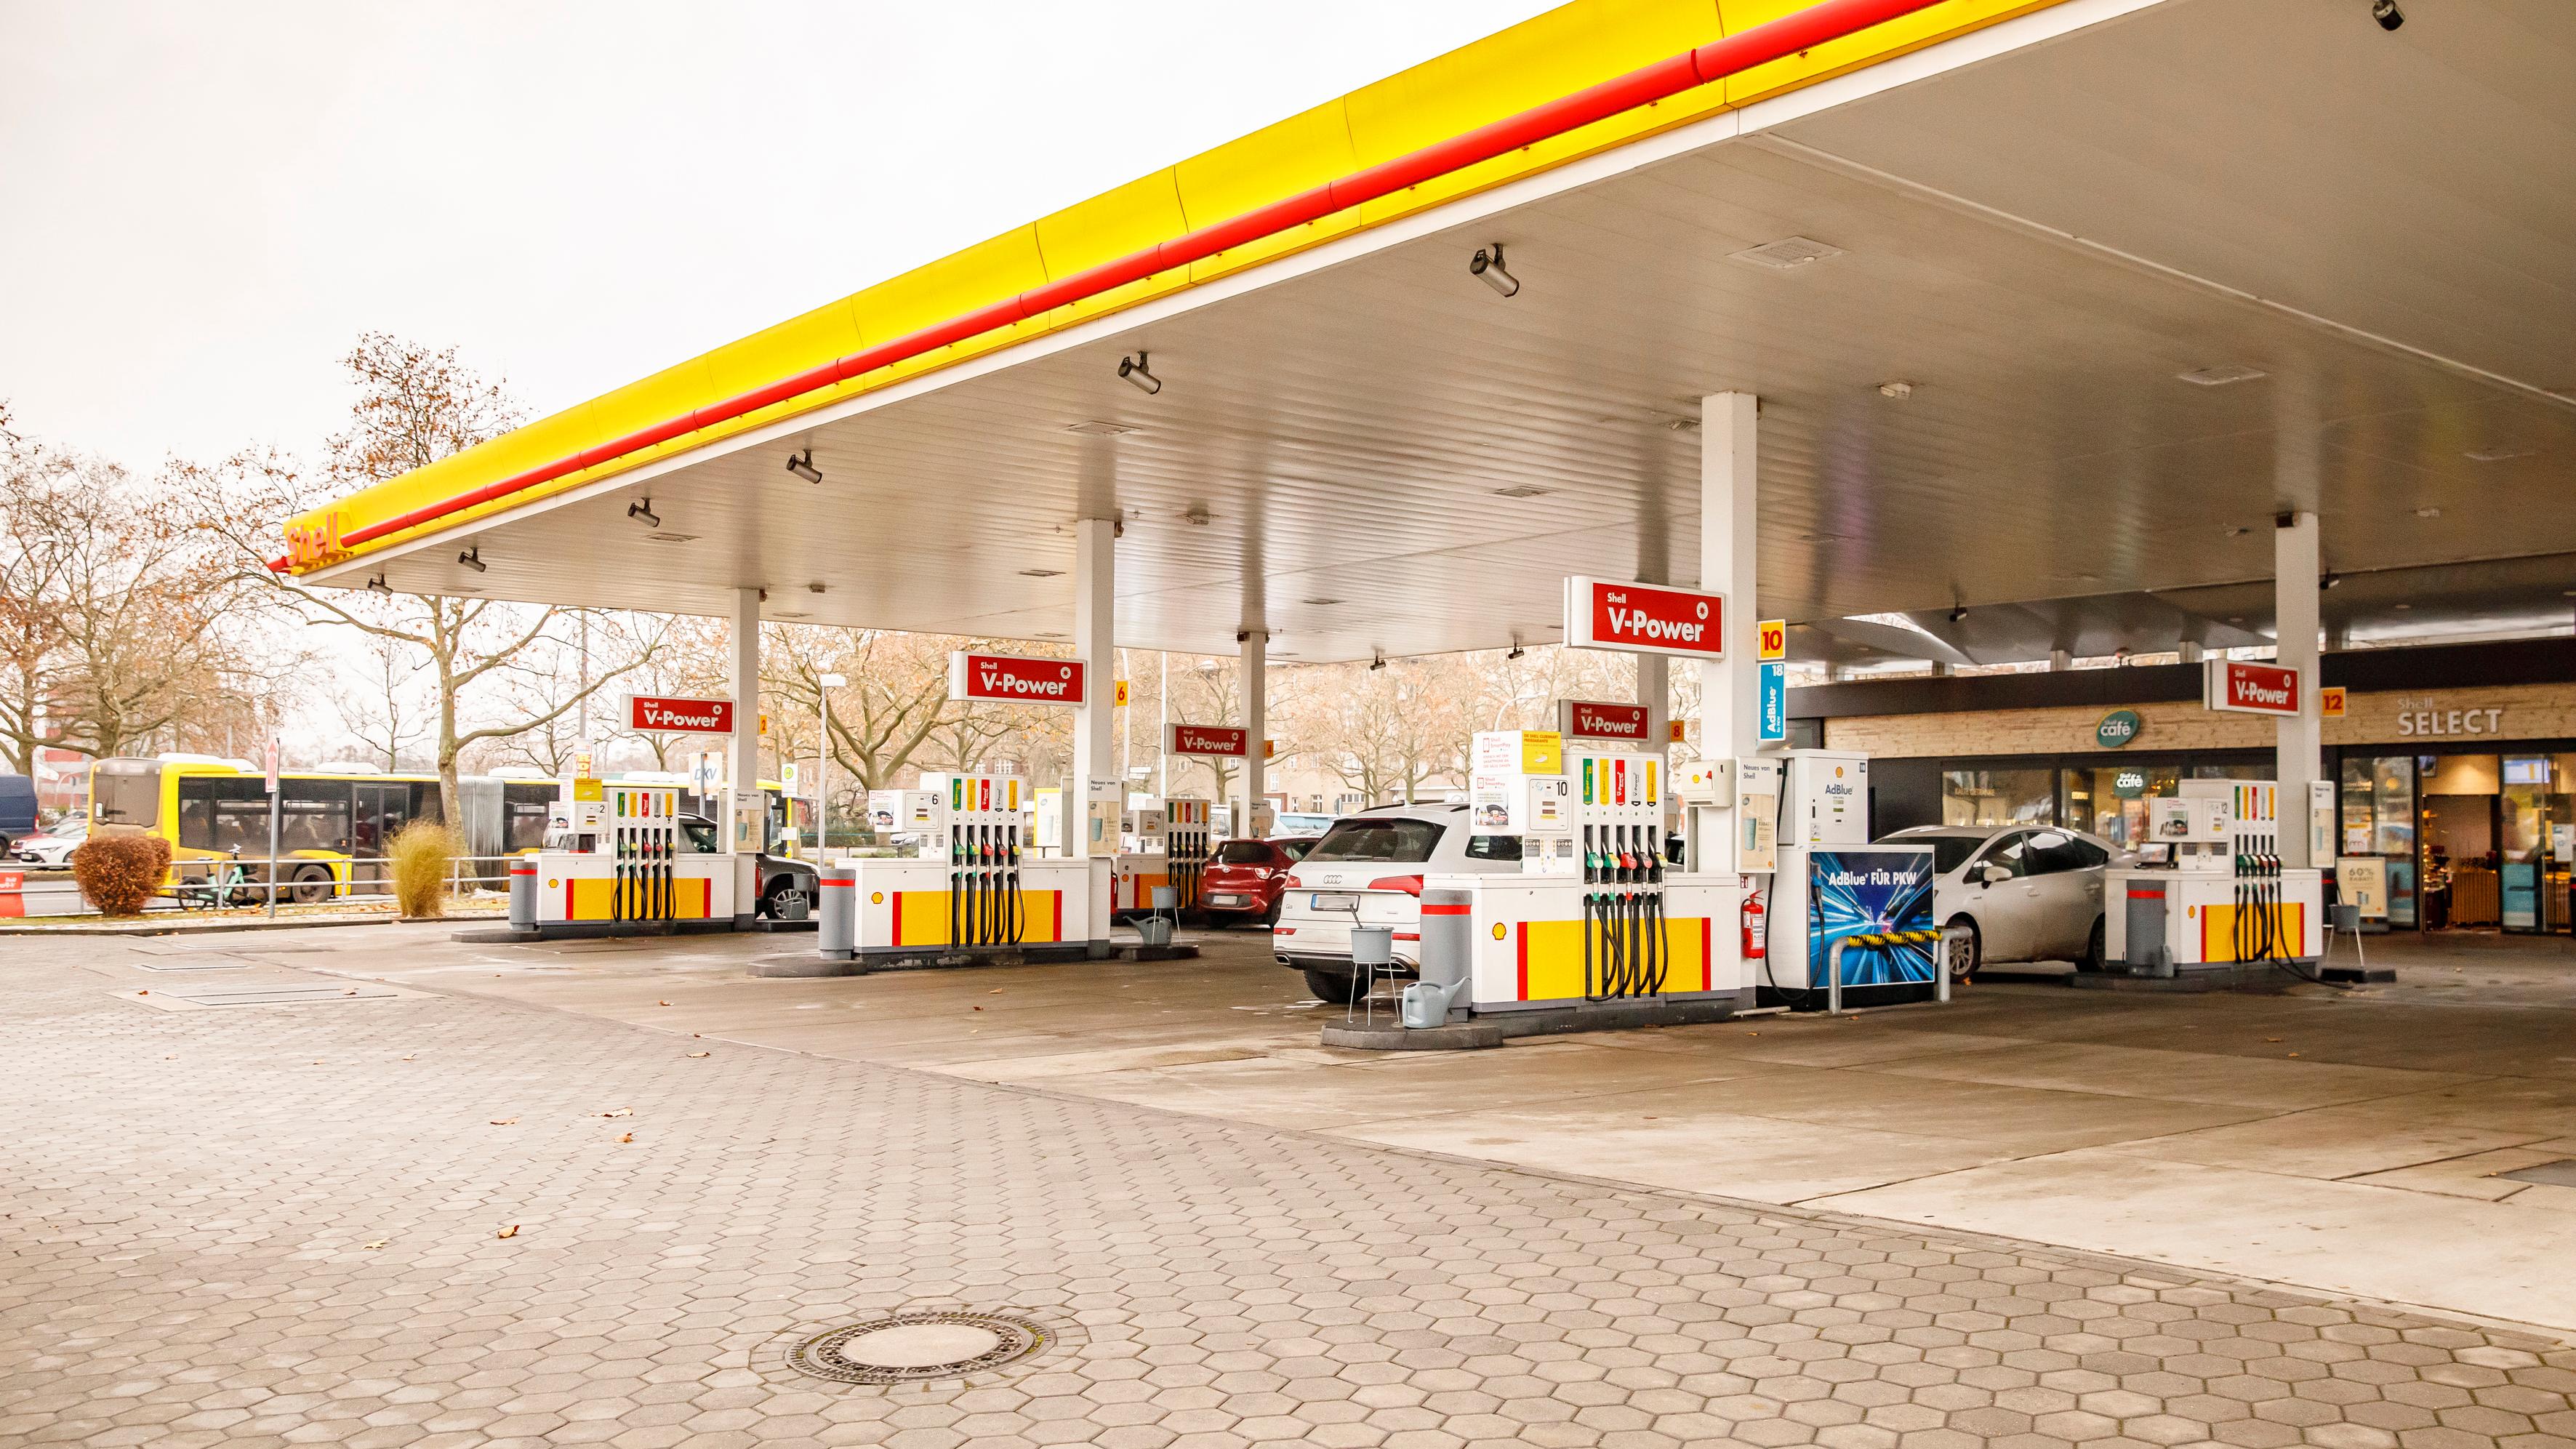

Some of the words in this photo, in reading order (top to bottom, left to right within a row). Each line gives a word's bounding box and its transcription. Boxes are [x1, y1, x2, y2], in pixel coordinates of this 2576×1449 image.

[286, 512, 337, 566] Shell
[1608, 593, 1626, 603] Shell
[1608, 606, 1704, 642] V-Power
[1762, 630, 1782, 651] 10
[1772, 665, 1783, 676] 18
[2235, 670, 2245, 678] Shell
[981, 672, 1067, 695] V-Power
[1118, 686, 1125, 701] 6
[2236, 681, 2289, 705] V-Power
[2324, 695, 2343, 710] 12
[2397, 697, 2433, 709] Shell
[644, 710, 718, 727] V-Power
[761, 720, 766, 731] 2
[1581, 715, 1637, 734] V-Power
[2398, 710, 2502, 736] SELECT
[1674, 726, 1680, 737] 8
[2100, 721, 2130, 736] café
[1184, 736, 1237, 752] V-Power
[1267, 744, 1272, 753] 4
[2116, 774, 2143, 788] café
[1557, 782, 1568, 796] 10
[932, 794, 939, 805] 6
[2221, 802, 2228, 814] 12
[1871, 868, 1890, 886] FÜR
[1893, 872, 1917, 885] PKW
[2349, 867, 2373, 876] 60%
